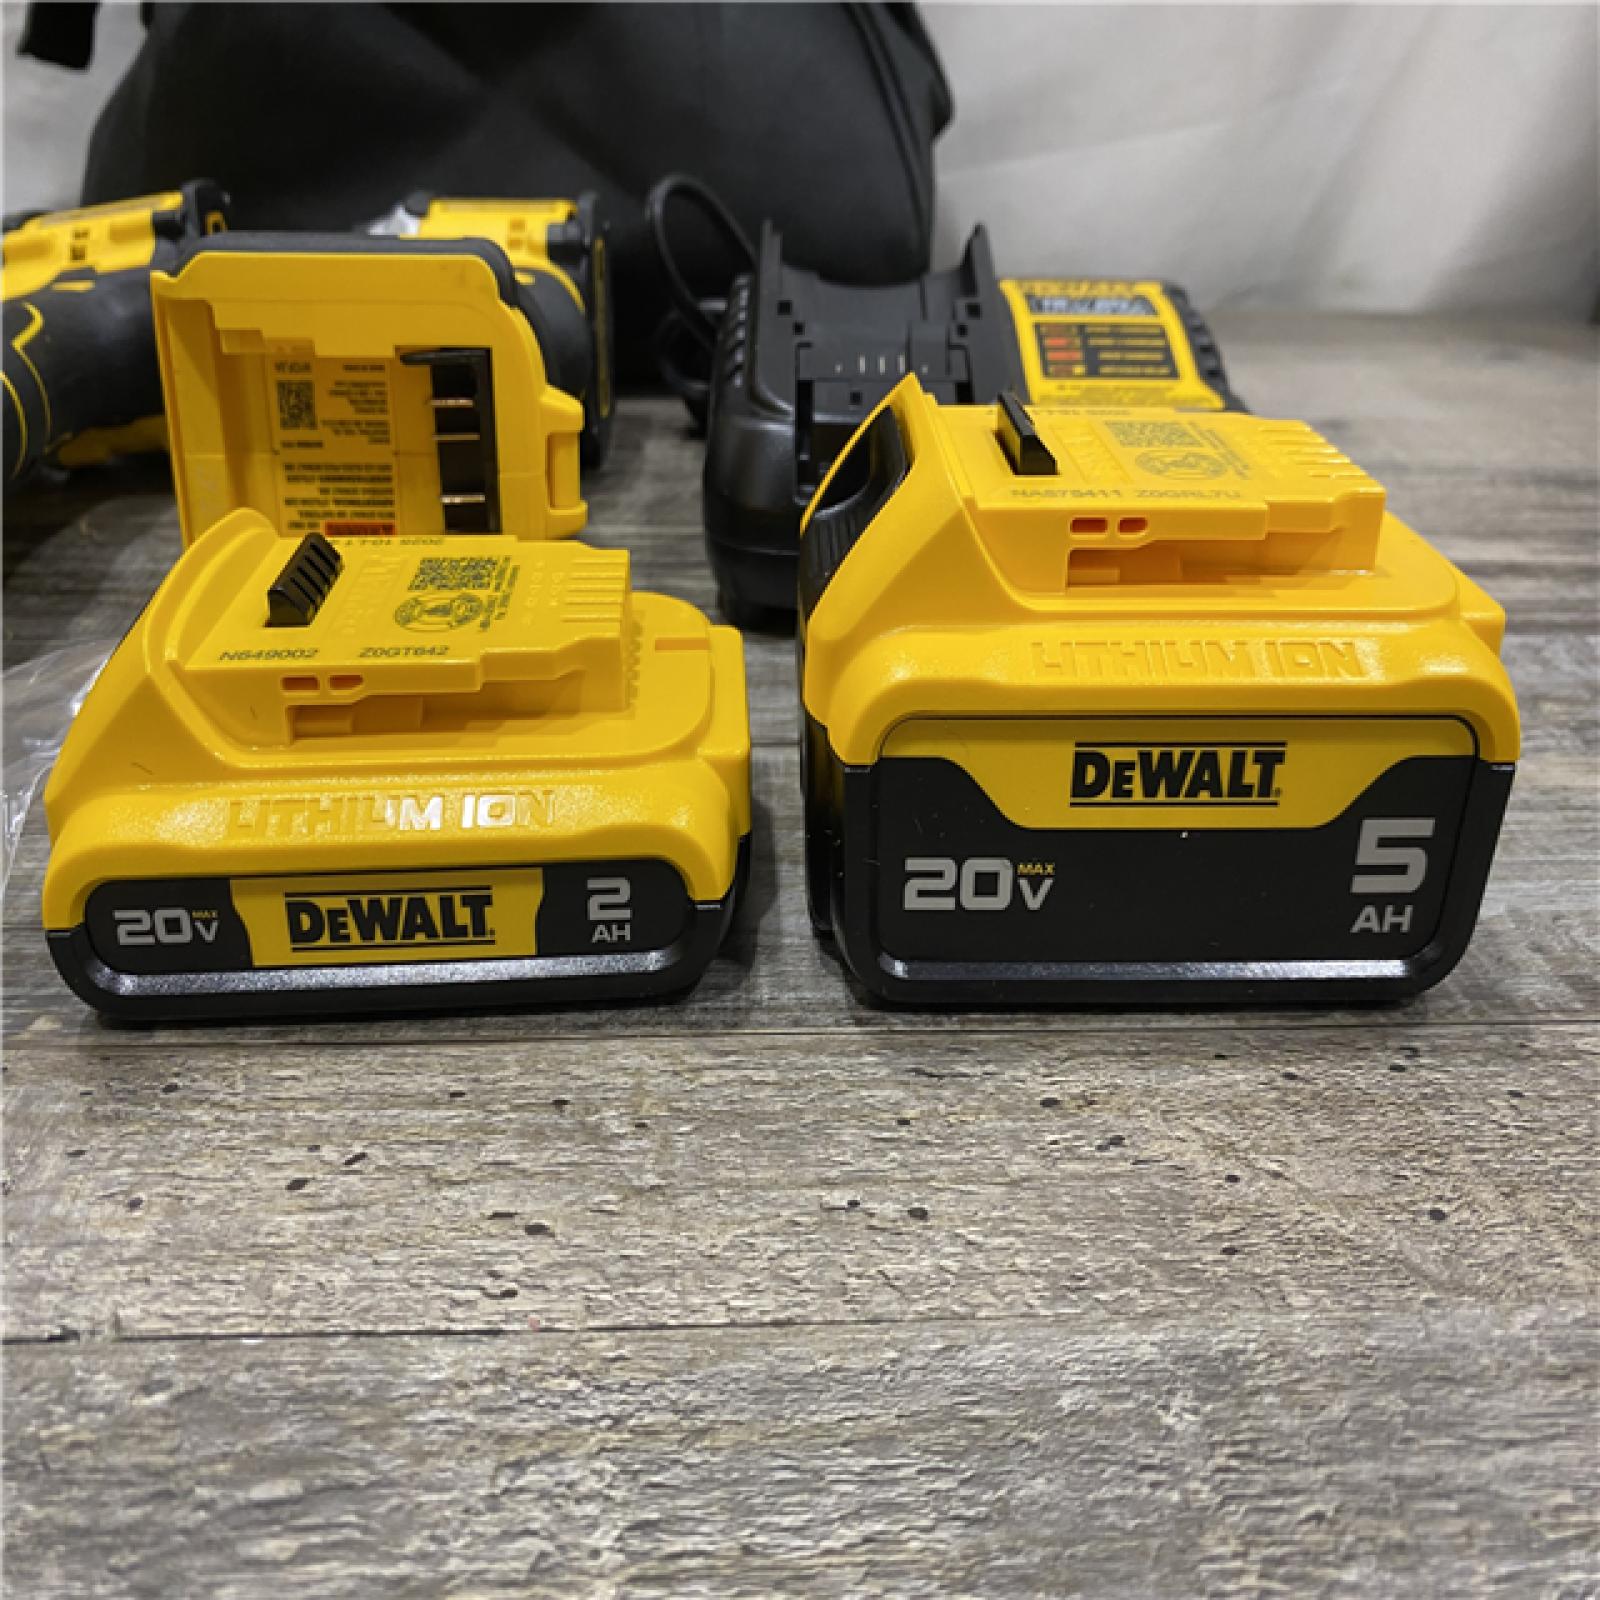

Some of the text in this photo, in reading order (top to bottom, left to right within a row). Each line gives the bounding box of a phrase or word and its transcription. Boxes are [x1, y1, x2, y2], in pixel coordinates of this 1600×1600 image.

[1031, 640, 1363, 678] LITHIUM ION
[226, 789, 555, 839] LITHIUM ION
[1017, 863, 1056, 875] MAX
[1350, 816, 1436, 893] 5
[586, 876, 632, 921] 2
[591, 922, 632, 944] AH
[1349, 903, 1414, 934] AH
